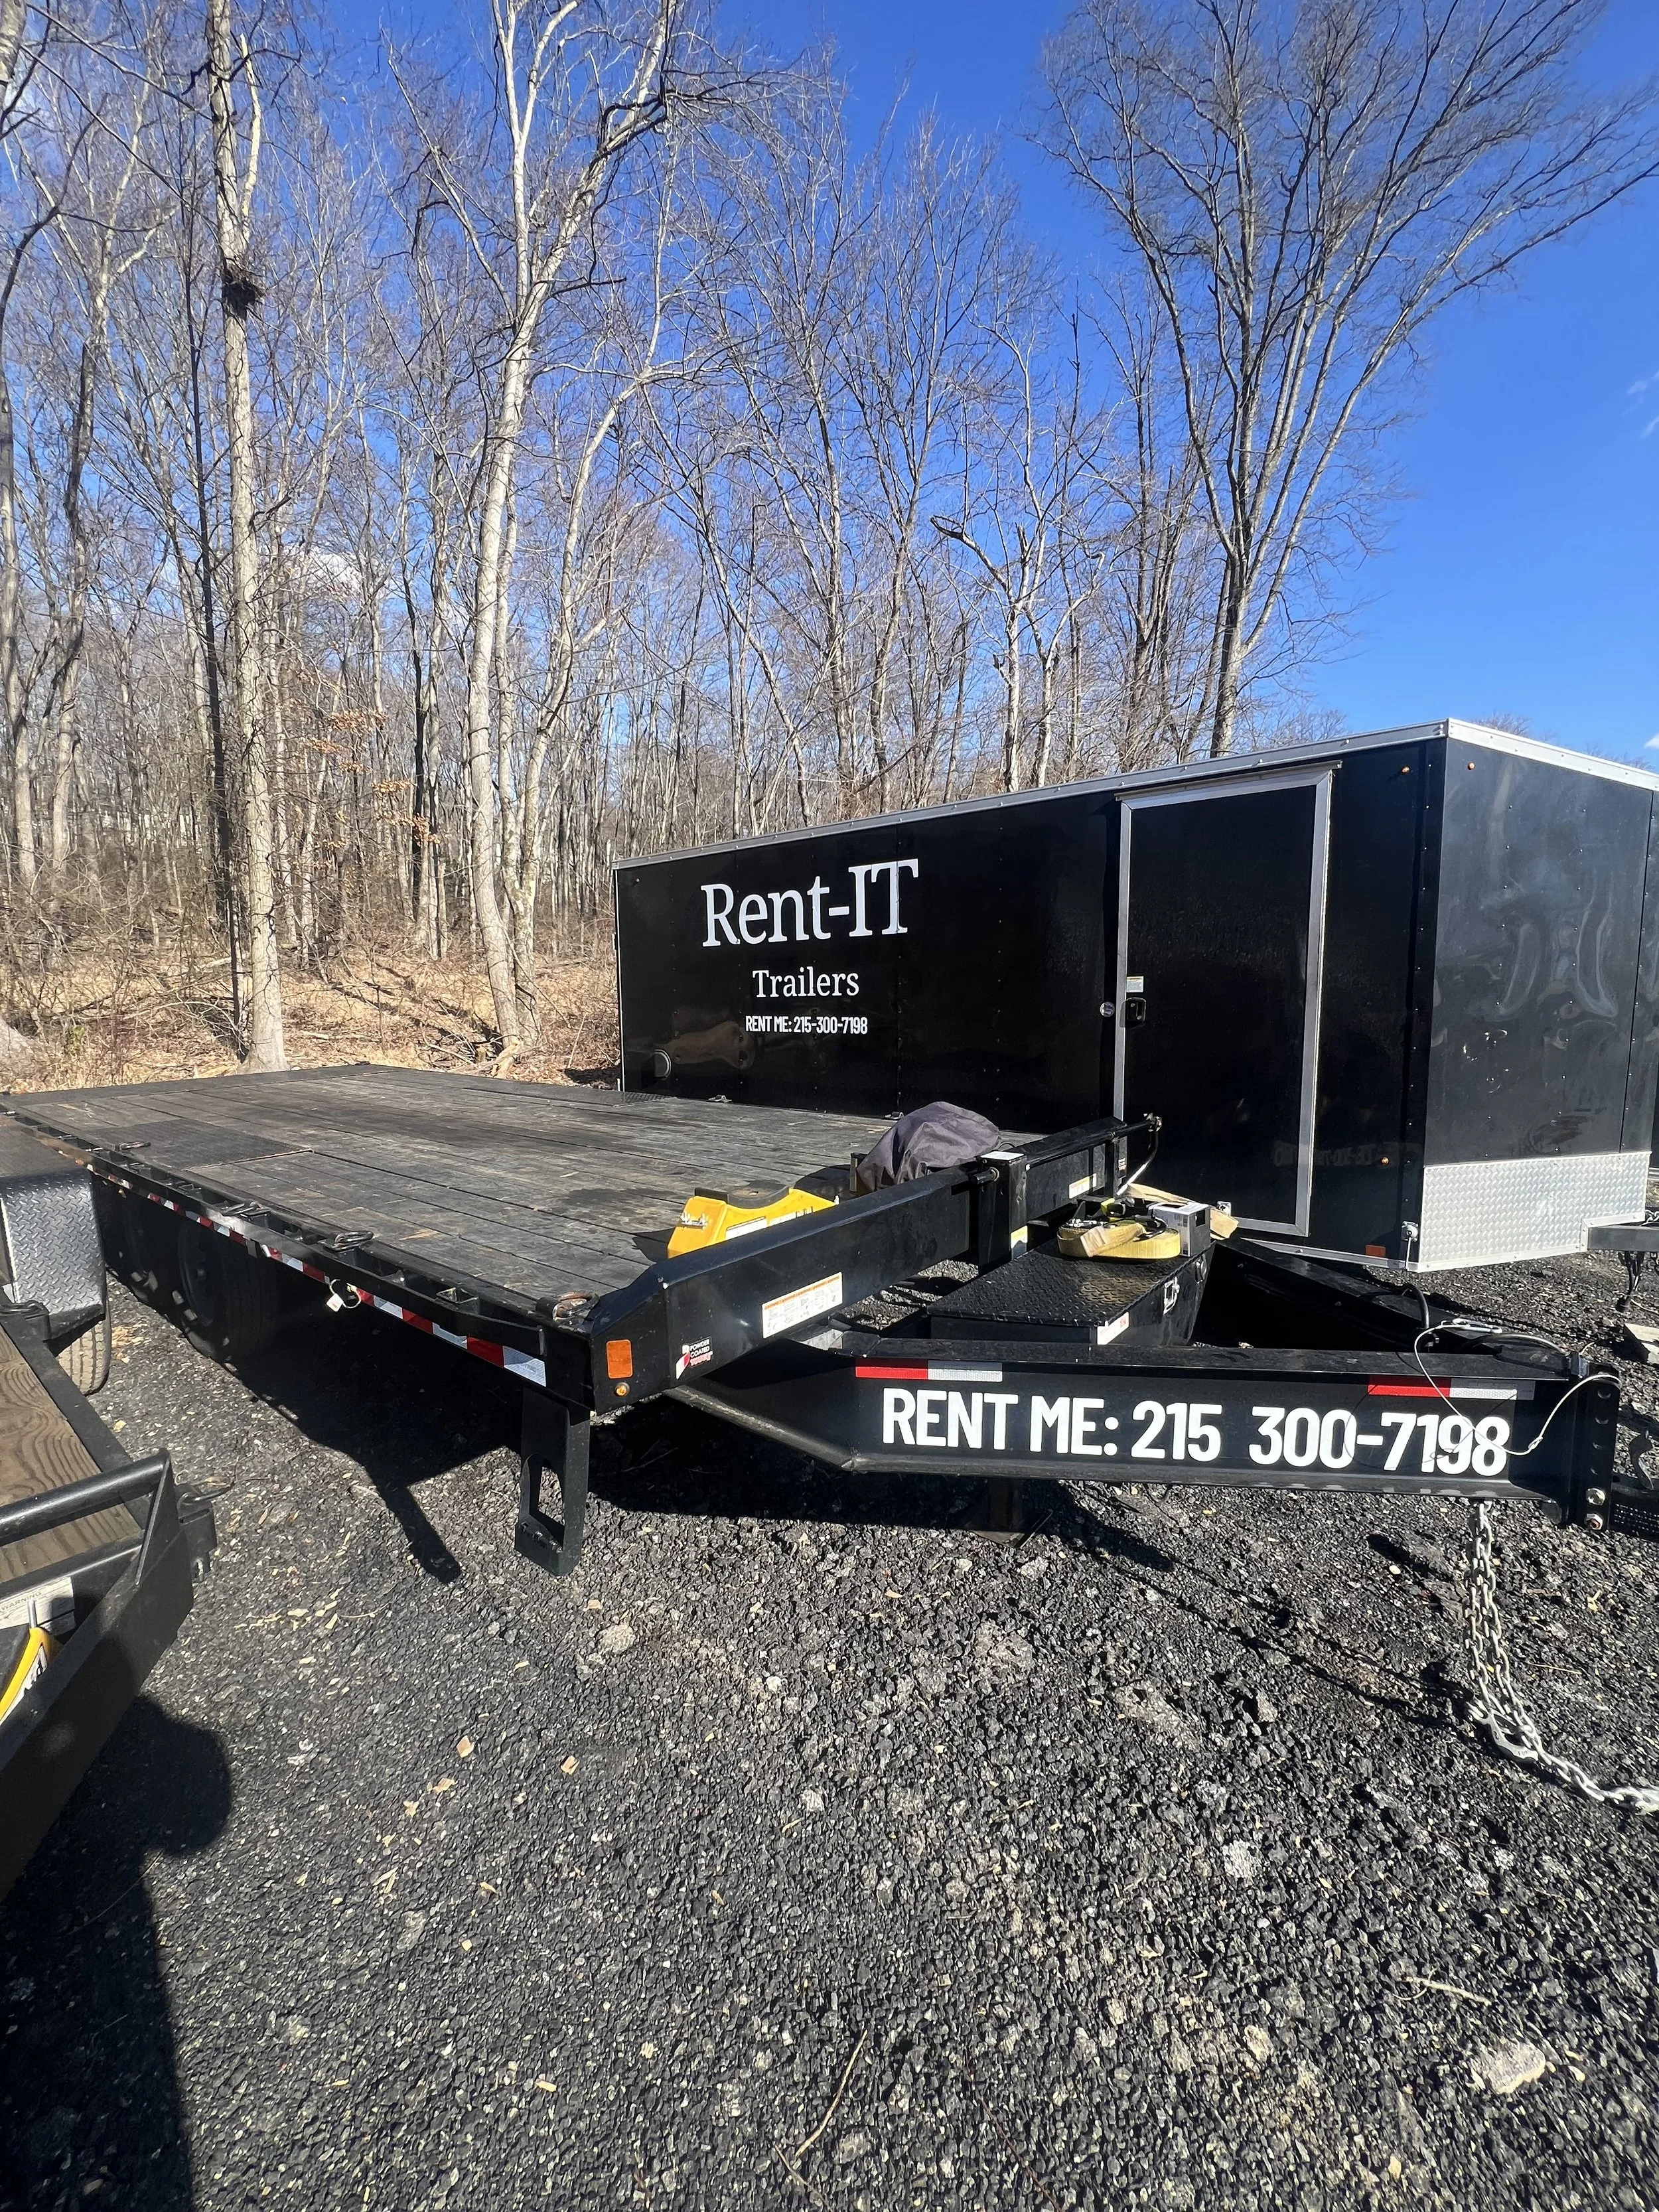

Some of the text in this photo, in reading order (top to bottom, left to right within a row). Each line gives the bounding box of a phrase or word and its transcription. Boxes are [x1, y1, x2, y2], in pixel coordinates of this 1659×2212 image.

[701, 859, 918, 946] Rent-IT
[753, 966, 859, 997] Trailers
[745, 1015, 868, 1035] RENT ME: 215-300-7198
[690, 1339, 710, 1351] POWDER
[690, 1345, 710, 1359] COATED
[883, 1388, 1510, 1477] RENT ME: 215 300-7198
